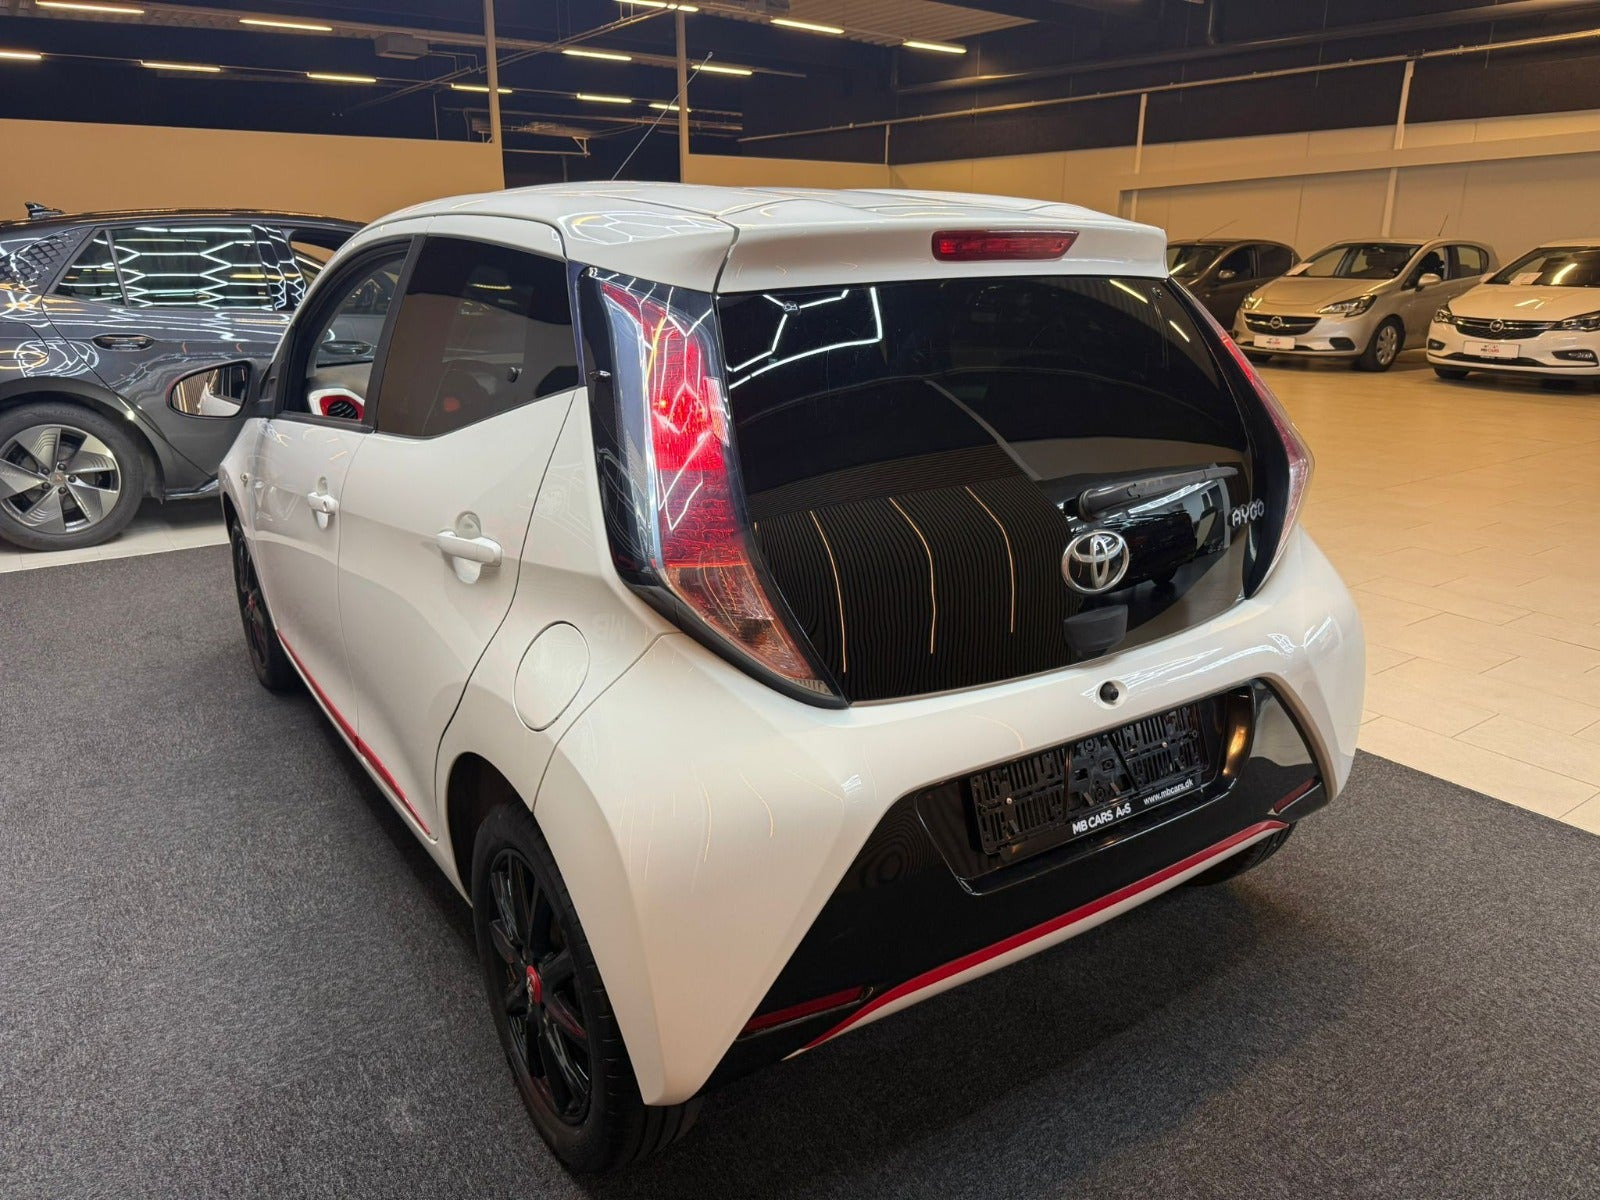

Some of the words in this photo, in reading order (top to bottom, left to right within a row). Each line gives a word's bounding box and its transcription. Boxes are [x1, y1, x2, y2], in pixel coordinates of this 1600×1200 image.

[1231, 499, 1265, 527] AYGO
[1071, 819, 1088, 835] MB
[1088, 809, 1113, 827] CARS
[1143, 778, 1194, 805] www.mbcars.dk
